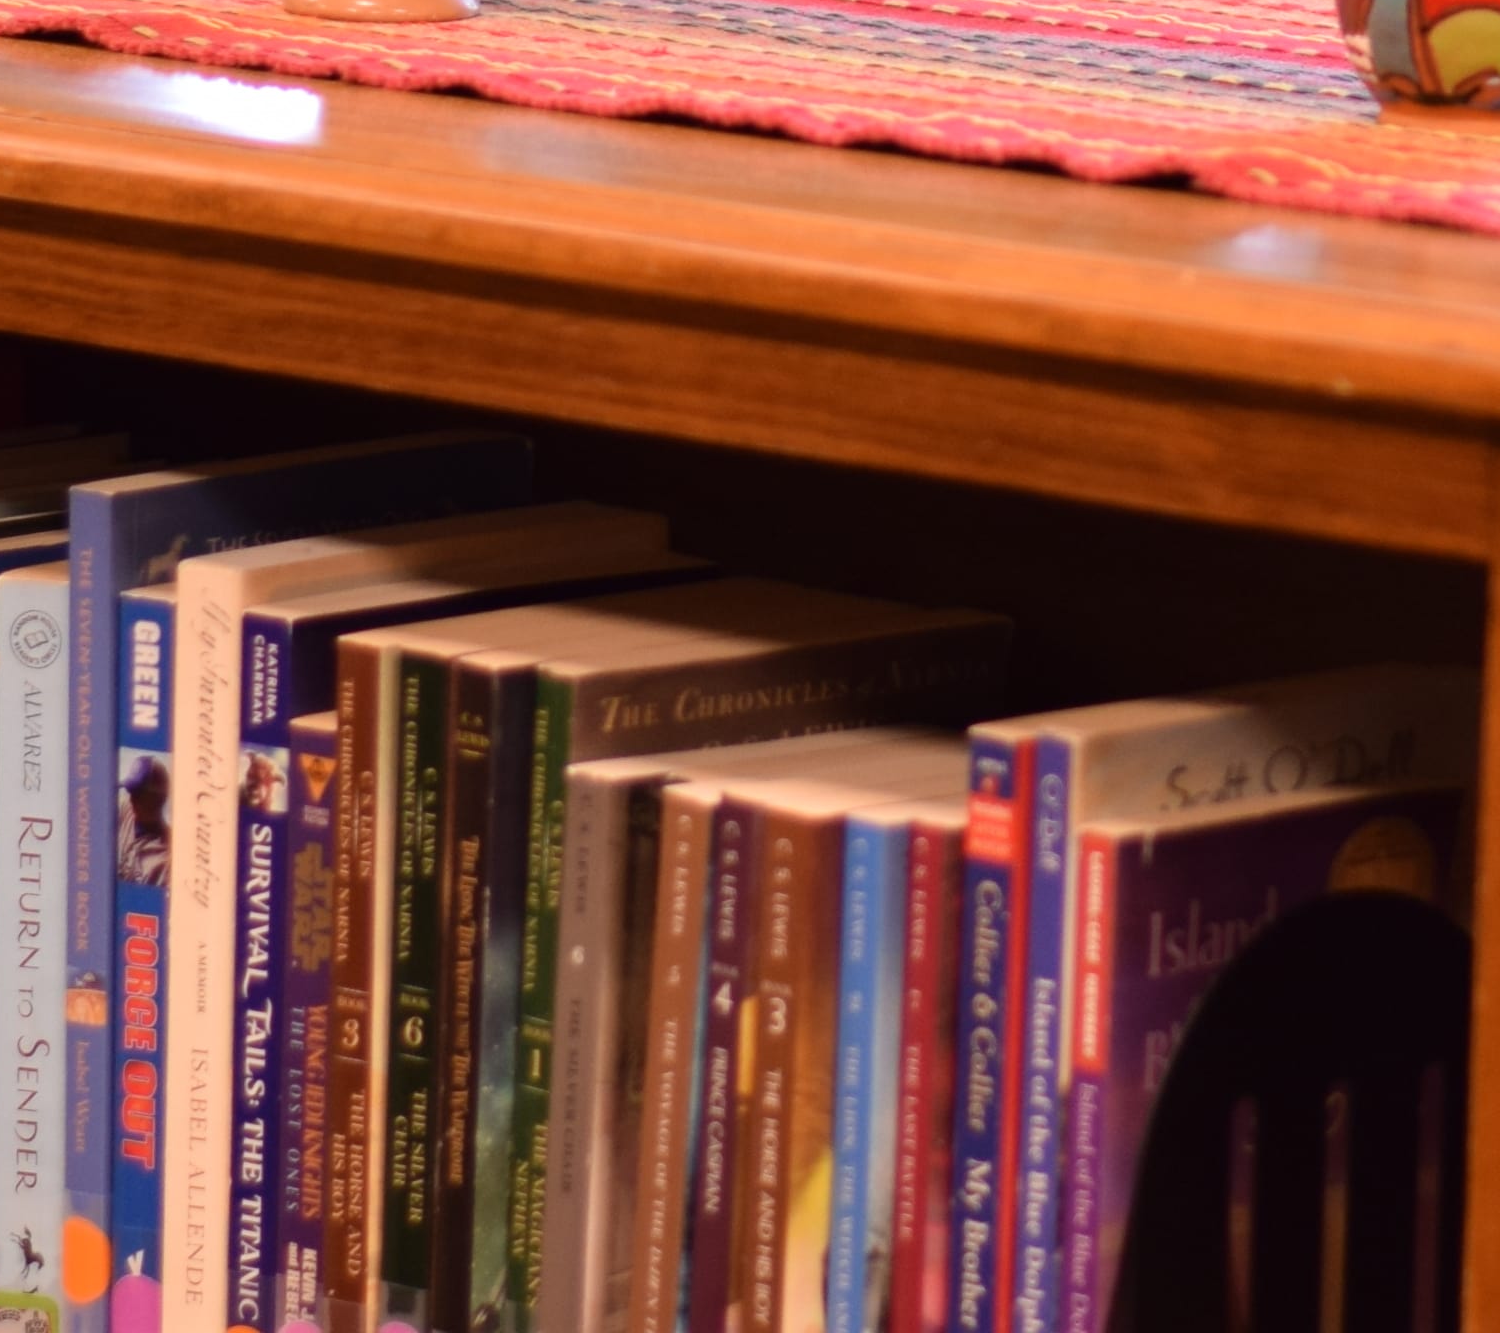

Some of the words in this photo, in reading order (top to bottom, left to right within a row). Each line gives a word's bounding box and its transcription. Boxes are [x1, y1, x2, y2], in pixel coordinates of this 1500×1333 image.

[133, 620, 161, 727] GREEN
[251, 634, 266, 725] CHARMAN
[265, 642, 279, 720] KATRINA
[23, 680, 42, 793] ALVAREZ
[18, 816, 53, 970] RETURN
[243, 823, 272, 998] SURVIVAL
[18, 986, 34, 1019] TO
[123, 912, 159, 1052] FORCE
[404, 1015, 424, 1046] 6
[715, 980, 733, 1015] 4
[768, 996, 786, 1035] 3
[188, 1047, 209, 1152] ISABEL
[243, 997, 273, 1107] TAILS:
[14, 1035, 50, 1193] SENDER
[122, 1058, 158, 1170] OUT
[241, 1117, 265, 1183] THE
[185, 1161, 207, 1307] ALLENDE
[238, 1194, 263, 1322] TITANIC
